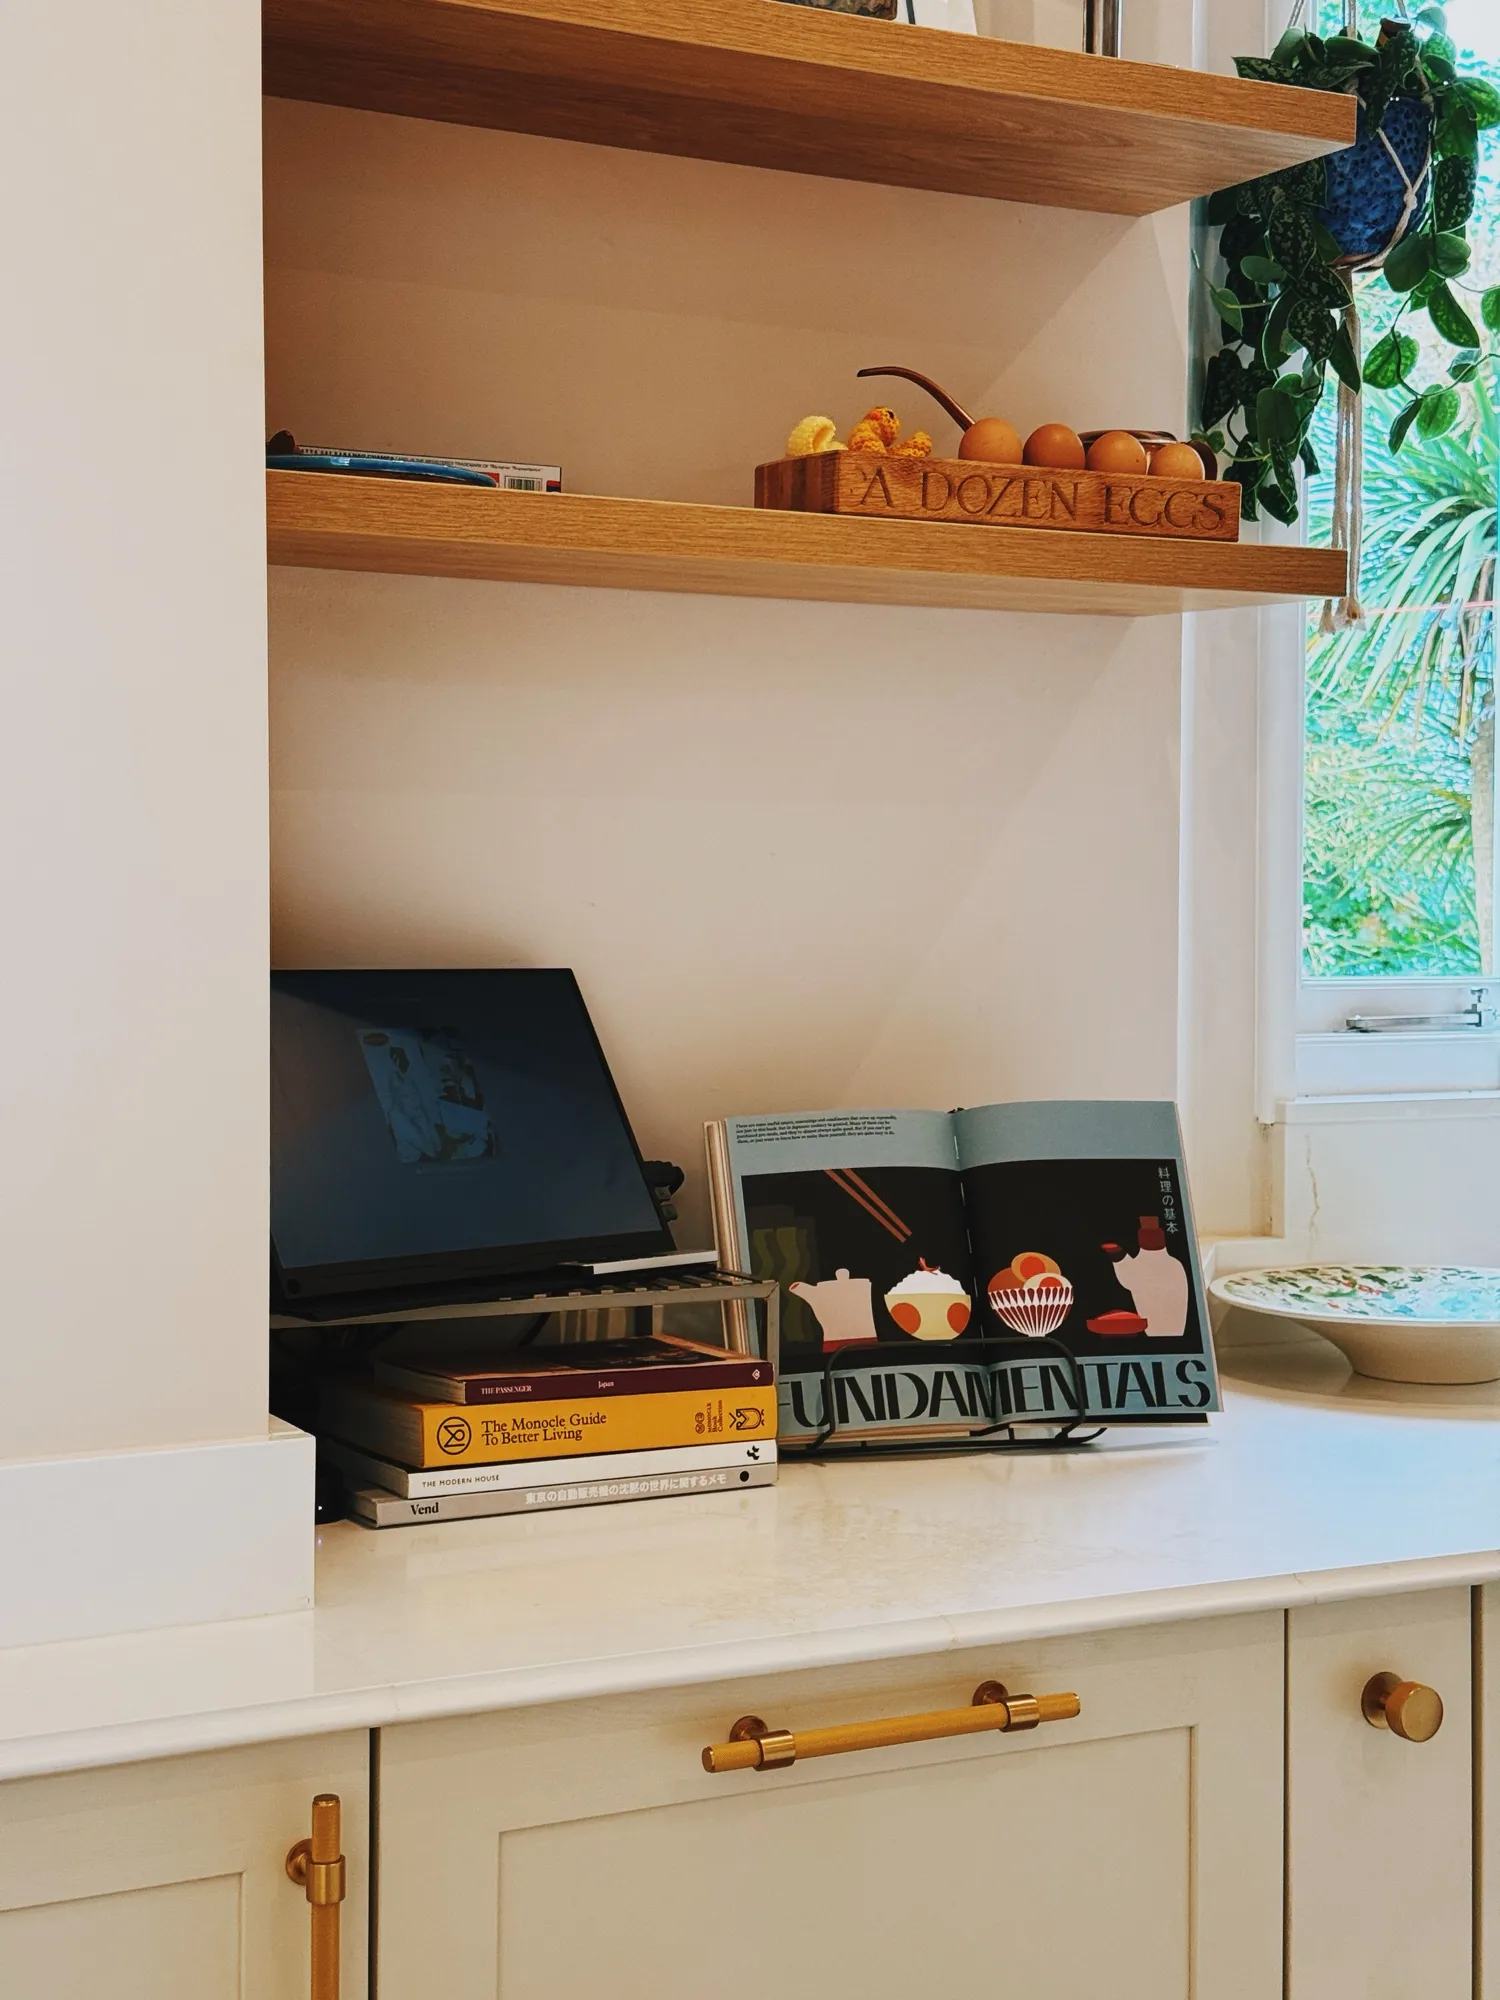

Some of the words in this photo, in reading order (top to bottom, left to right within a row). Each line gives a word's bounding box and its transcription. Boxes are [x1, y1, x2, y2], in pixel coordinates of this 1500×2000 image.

[861, 467, 895, 507] A
[920, 471, 1078, 520] DOZEN
[1103, 485, 1226, 530] EGGS
[481, 1387, 494, 1395] THE
[495, 1385, 532, 1394] PASSENGER
[598, 1380, 614, 1389] Japan
[481, 1419, 507, 1433] The
[512, 1415, 566, 1431] Monocle
[569, 1412, 607, 1426] Guide
[481, 1433, 498, 1446] To
[501, 1430, 540, 1445] Better
[543, 1426, 583, 1441] Living
[439, 1477, 472, 1486] MODERN
[475, 1474, 500, 1482] HOUSE
[410, 1502, 439, 1515] Vend
